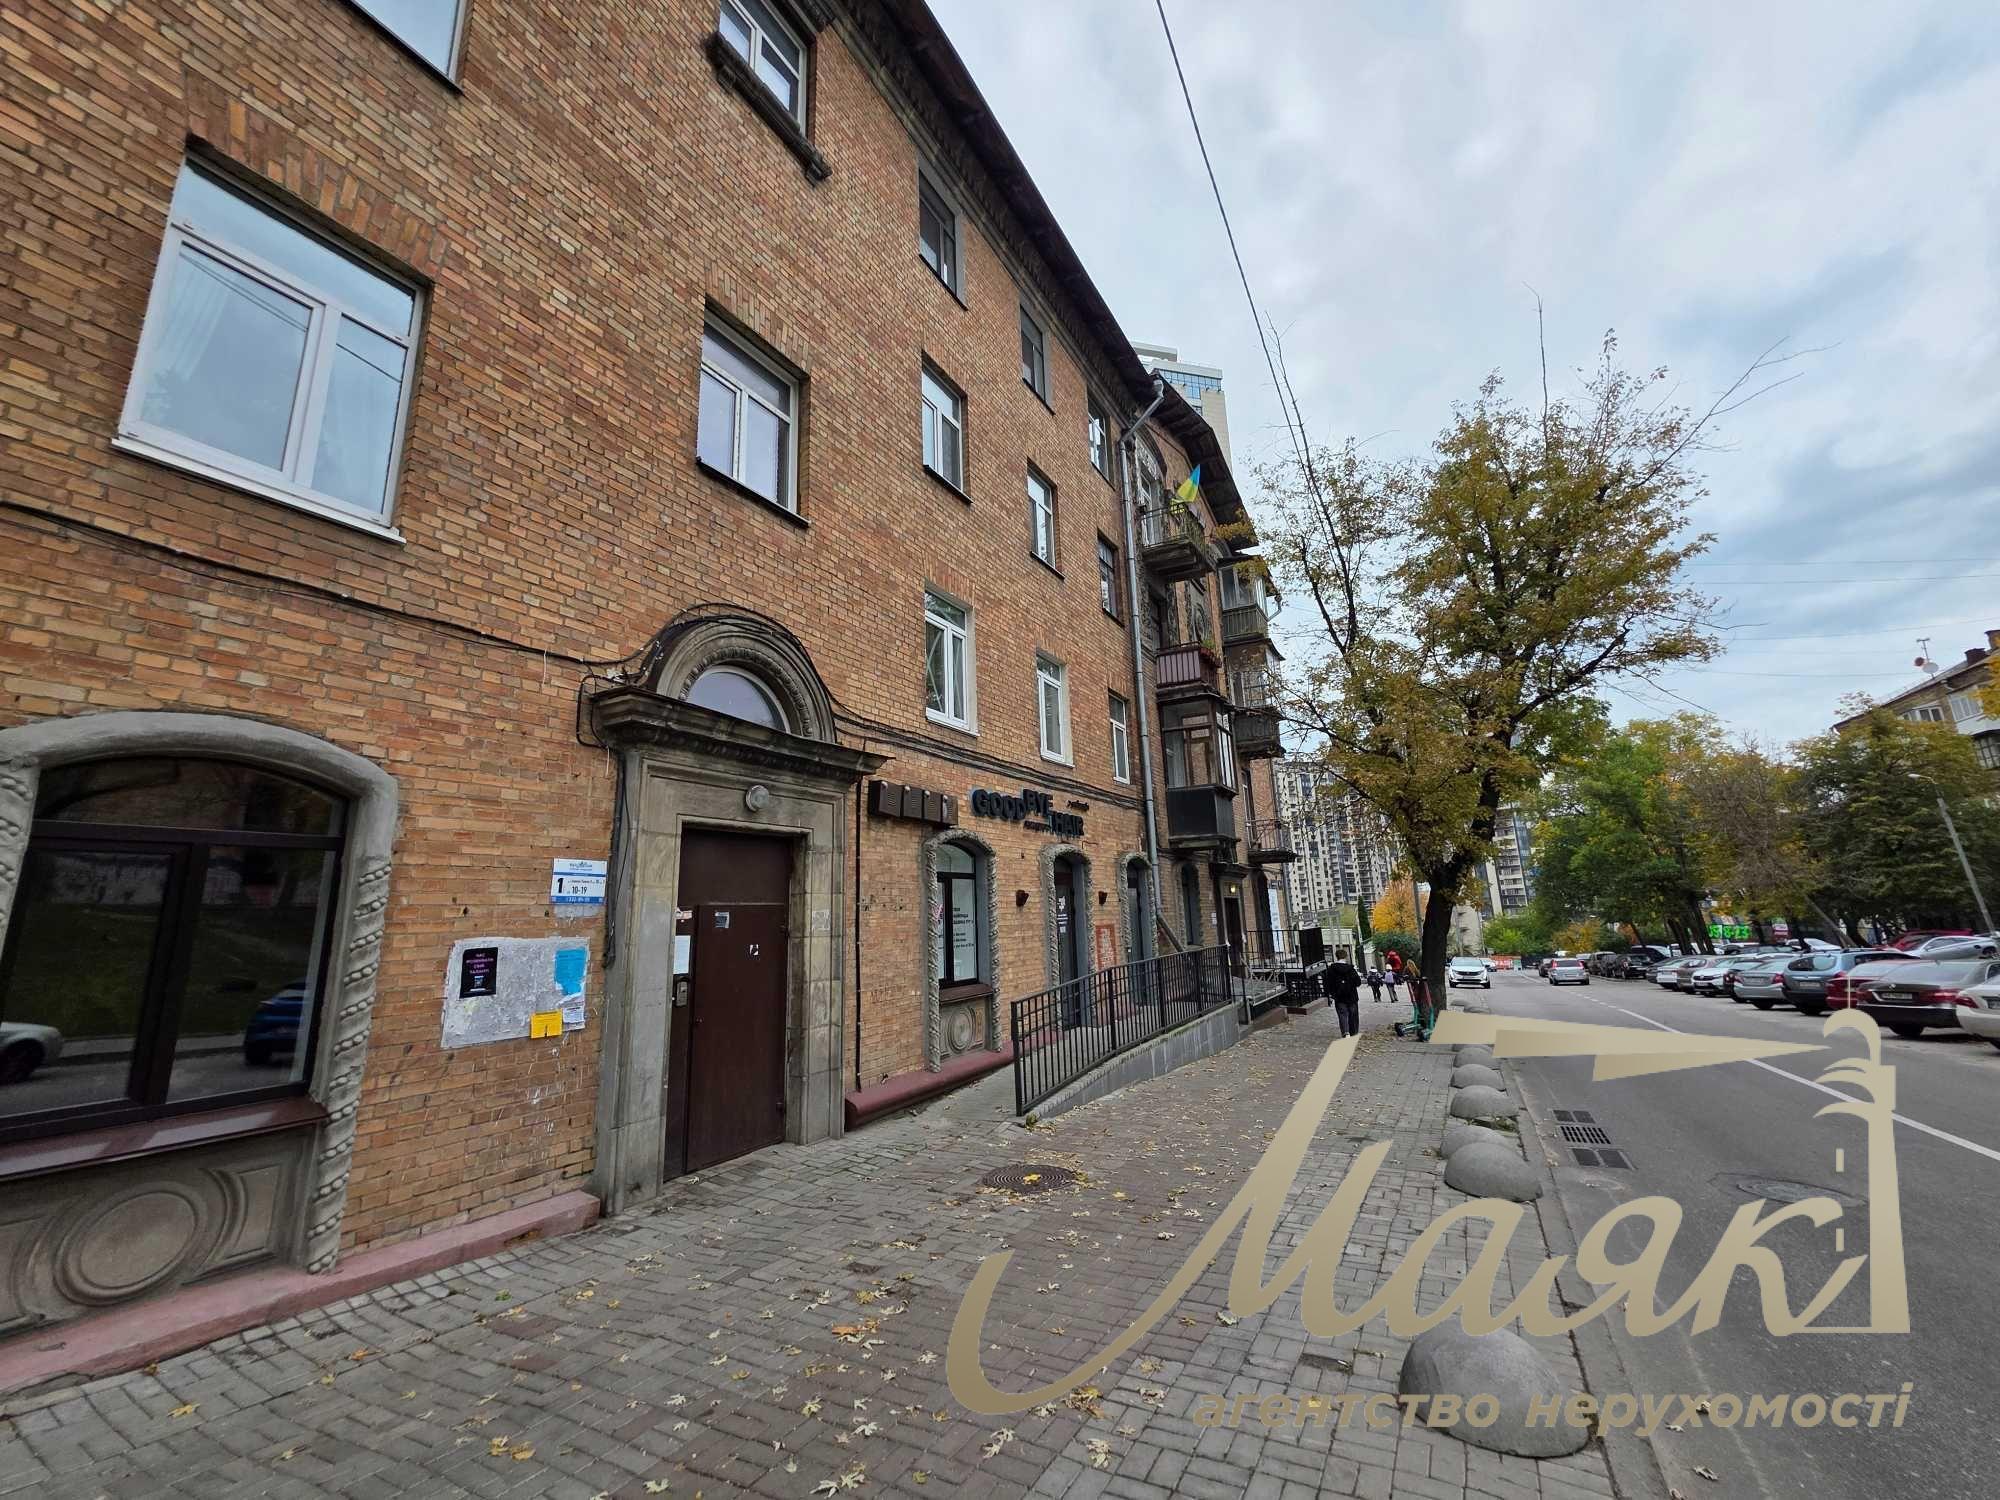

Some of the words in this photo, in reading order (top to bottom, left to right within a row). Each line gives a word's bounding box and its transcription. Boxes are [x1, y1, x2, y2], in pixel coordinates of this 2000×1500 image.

[972, 788, 1027, 821] GOOD
[1022, 788, 1054, 816] BYE
[1051, 811, 1085, 837] HAIR
[557, 877, 564, 894] 1
[572, 886, 588, 895] 10-19
